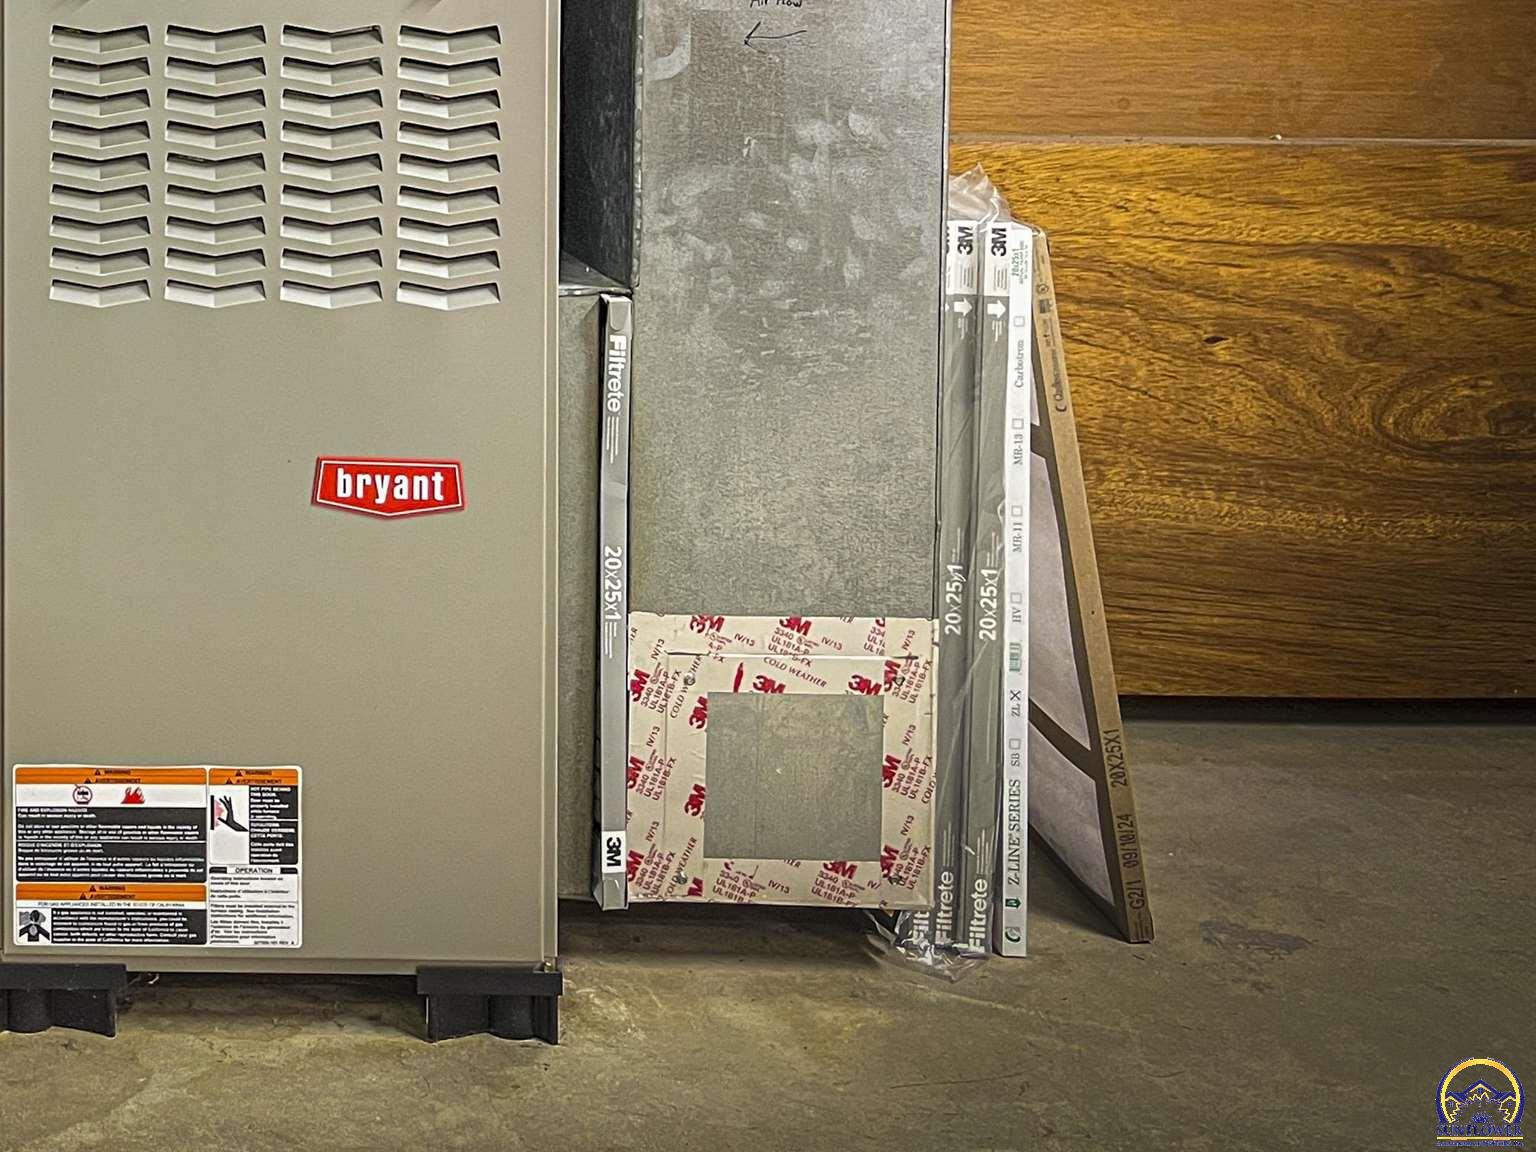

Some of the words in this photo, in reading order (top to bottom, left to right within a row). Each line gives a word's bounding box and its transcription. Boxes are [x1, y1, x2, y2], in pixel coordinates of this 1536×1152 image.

[958, 226, 973, 255] 3M
[991, 228, 1007, 257] 3M
[607, 334, 627, 413] Filtrete
[1014, 339, 1024, 389] Carbotron
[1012, 433, 1023, 466] MR-13
[336, 467, 444, 504] bryant
[604, 545, 623, 620] 20x25x1
[979, 568, 998, 641] 20x25x1
[1011, 607, 1022, 623] HV
[734, 632, 756, 647] IV/13
[779, 616, 812, 636] 3M
[650, 638, 665, 661] IV/13
[770, 635, 810, 656] UL181A-P
[821, 636, 843, 651] IV/13
[630, 668, 651, 703] 3M
[752, 675, 786, 694] 3M
[764, 656, 787, 671] COLD
[788, 666, 827, 688] WEATHER
[848, 674, 882, 696] 3M
[884, 659, 901, 692] 3M
[908, 659, 934, 705] UL181B-FX
[640, 686, 654, 708] 3340
[648, 671, 670, 710] UL181A-P
[670, 694, 685, 719] COLD
[689, 696, 708, 729] 3M
[645, 725, 661, 747] IV/13
[902, 723, 917, 746] IV/13
[627, 755, 646, 789] 3M
[882, 754, 902, 788] 3M
[1010, 751, 1021, 767] SB
[1103, 728, 1128, 789] 20X25X1
[643, 758, 665, 798] UL181A-P
[900, 756, 921, 797] UL181A-P
[907, 755, 934, 800] UL181B-FX
[684, 783, 706, 817] 3M
[1007, 779, 1021, 833] SERIES
[645, 820, 660, 842] IV/13
[900, 814, 915, 837] IV/13
[606, 835, 622, 867] 3M
[627, 849, 645, 882] 3M
[880, 843, 900, 879] 3M
[898, 846, 919, 887] UL181A-P
[642, 852, 665, 891] UL181A-P
[822, 860, 858, 880] 3M
[906, 845, 931, 891] UL181B-FX
[716, 877, 757, 899] UL181A-P
[768, 879, 790, 895] IV/13
[814, 877, 856, 899] UL181A-P
[935, 871, 954, 945] Filtrete
[968, 878, 988, 953] Filtrete
[913, 910, 930, 945] Filt
